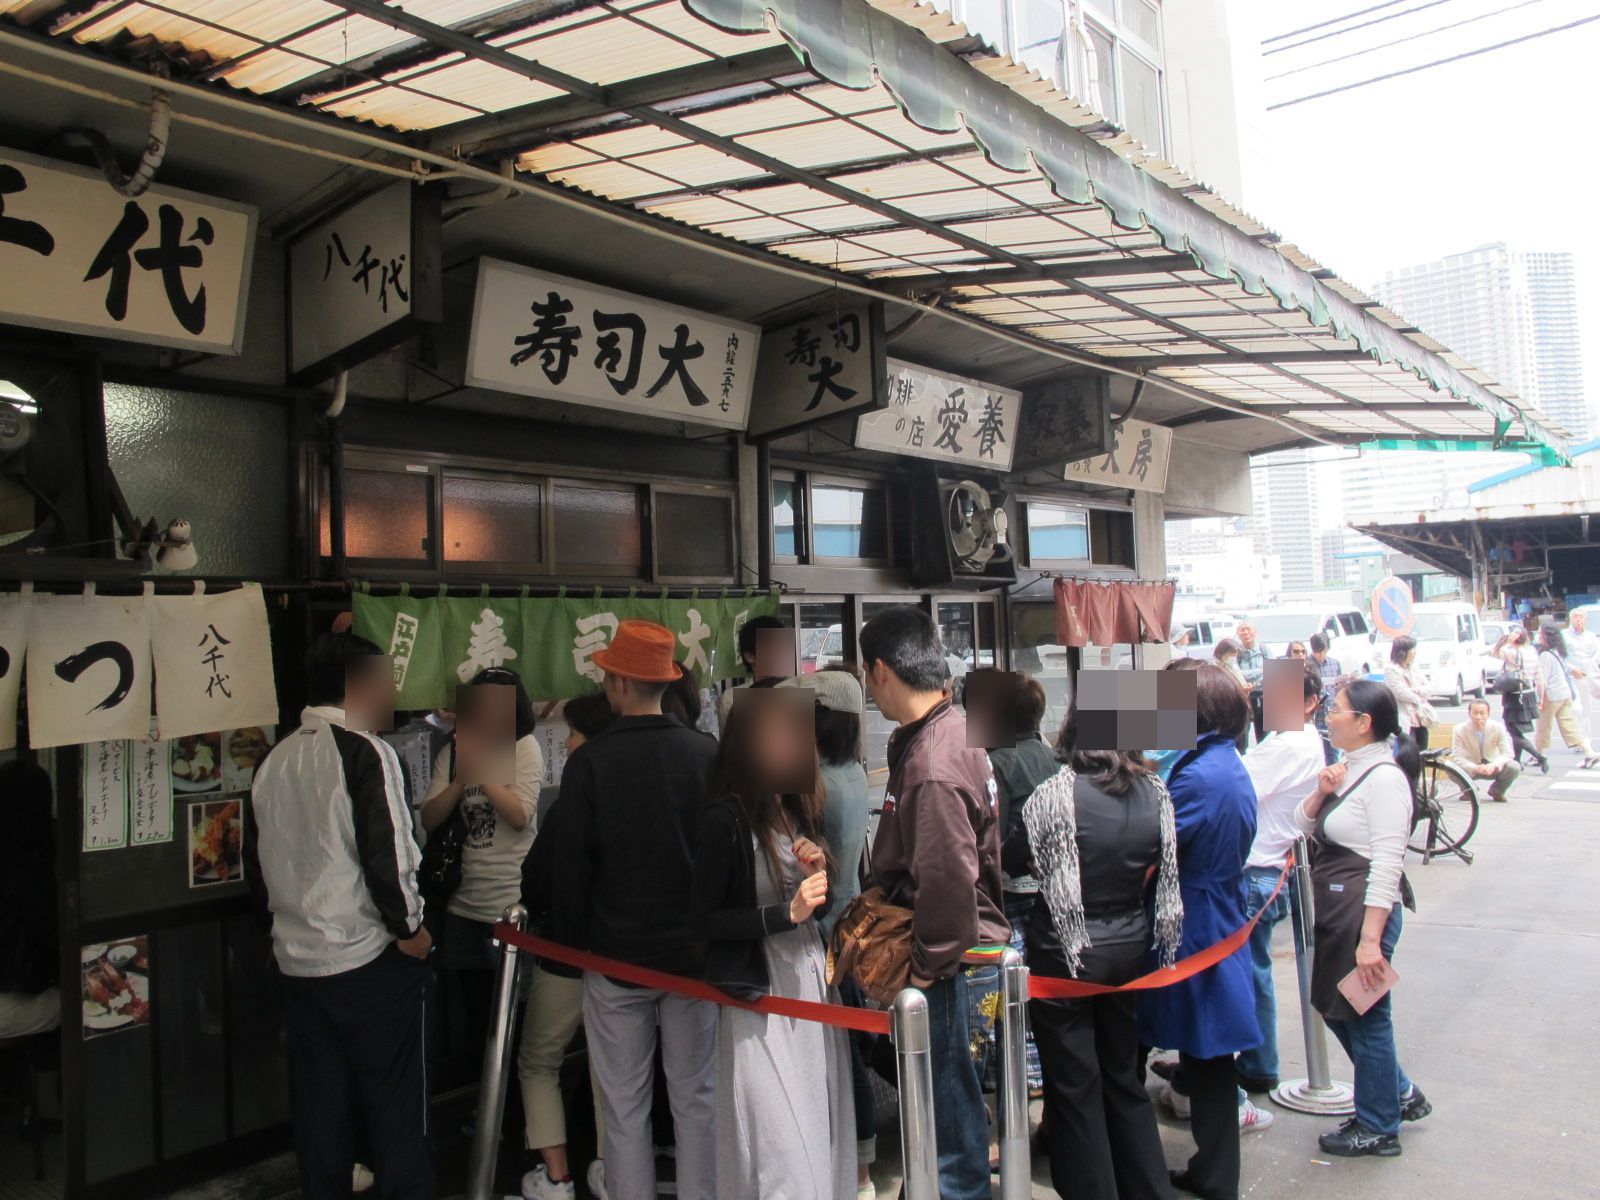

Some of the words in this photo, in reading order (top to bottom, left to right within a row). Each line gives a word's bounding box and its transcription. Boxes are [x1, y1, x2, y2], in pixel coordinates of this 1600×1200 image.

[323, 231, 410, 314] 八千代
[510, 291, 710, 407] 寿司大
[784, 312, 861, 412] 寿司大
[895, 415, 926, 449] の店
[932, 386, 1006, 460] 愛養
[198, 623, 232, 698] 八千代
[458, 607, 711, 684] 寿司大
